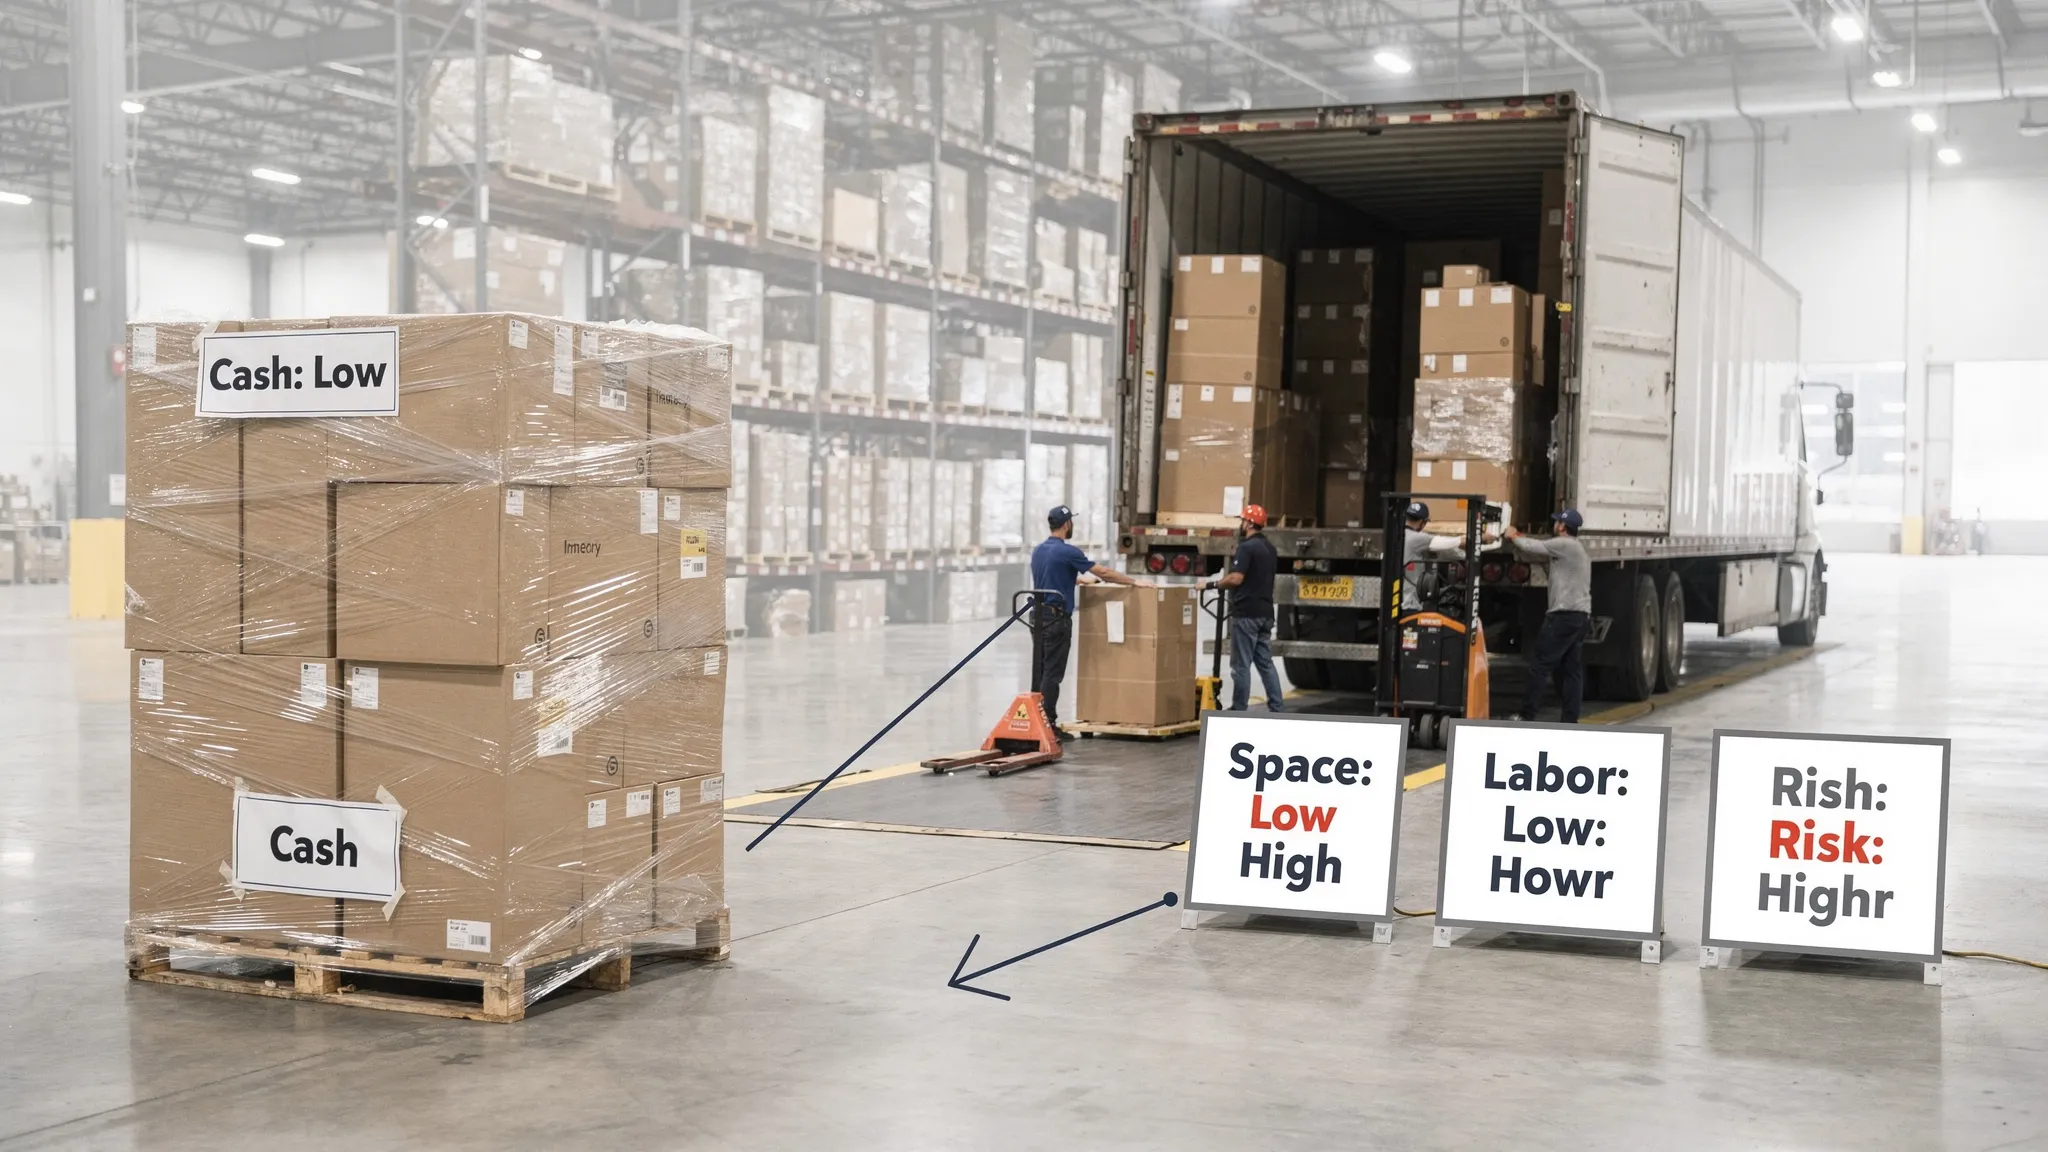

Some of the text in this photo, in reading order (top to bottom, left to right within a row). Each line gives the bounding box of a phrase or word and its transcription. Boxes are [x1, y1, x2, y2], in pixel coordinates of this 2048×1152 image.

[209, 354, 388, 391] Cash: Low
[1228, 742, 1373, 792] Space:
[1484, 750, 1629, 797] Labor:
[1772, 766, 1888, 811] Rish:
[1250, 794, 1338, 833] Low
[1503, 805, 1607, 847] Low:
[269, 824, 358, 868] Cash
[1769, 818, 1885, 864] Risk:
[1240, 840, 1342, 893] High
[1490, 855, 1614, 899] Howr
[1758, 871, 1894, 927] Highr
